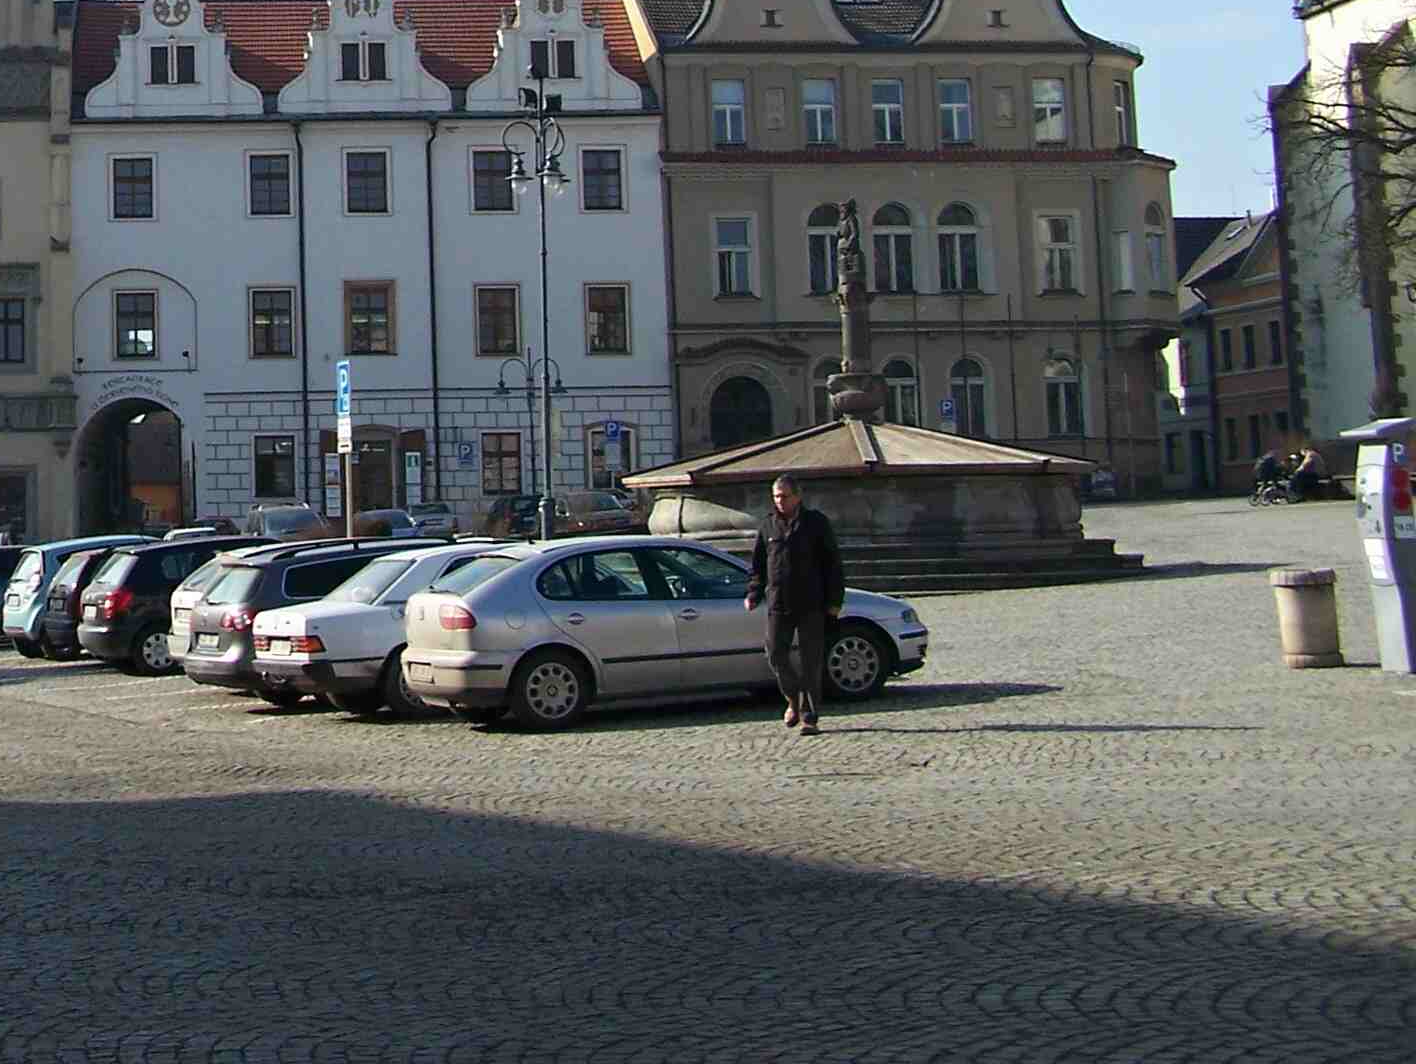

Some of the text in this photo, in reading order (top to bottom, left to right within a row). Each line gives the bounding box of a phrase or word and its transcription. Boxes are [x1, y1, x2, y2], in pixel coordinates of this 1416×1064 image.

[340, 369, 348, 398] P
[943, 401, 953, 415] P
[606, 422, 618, 435] P
[460, 443, 472, 457] P
[1392, 442, 1404, 463] P
